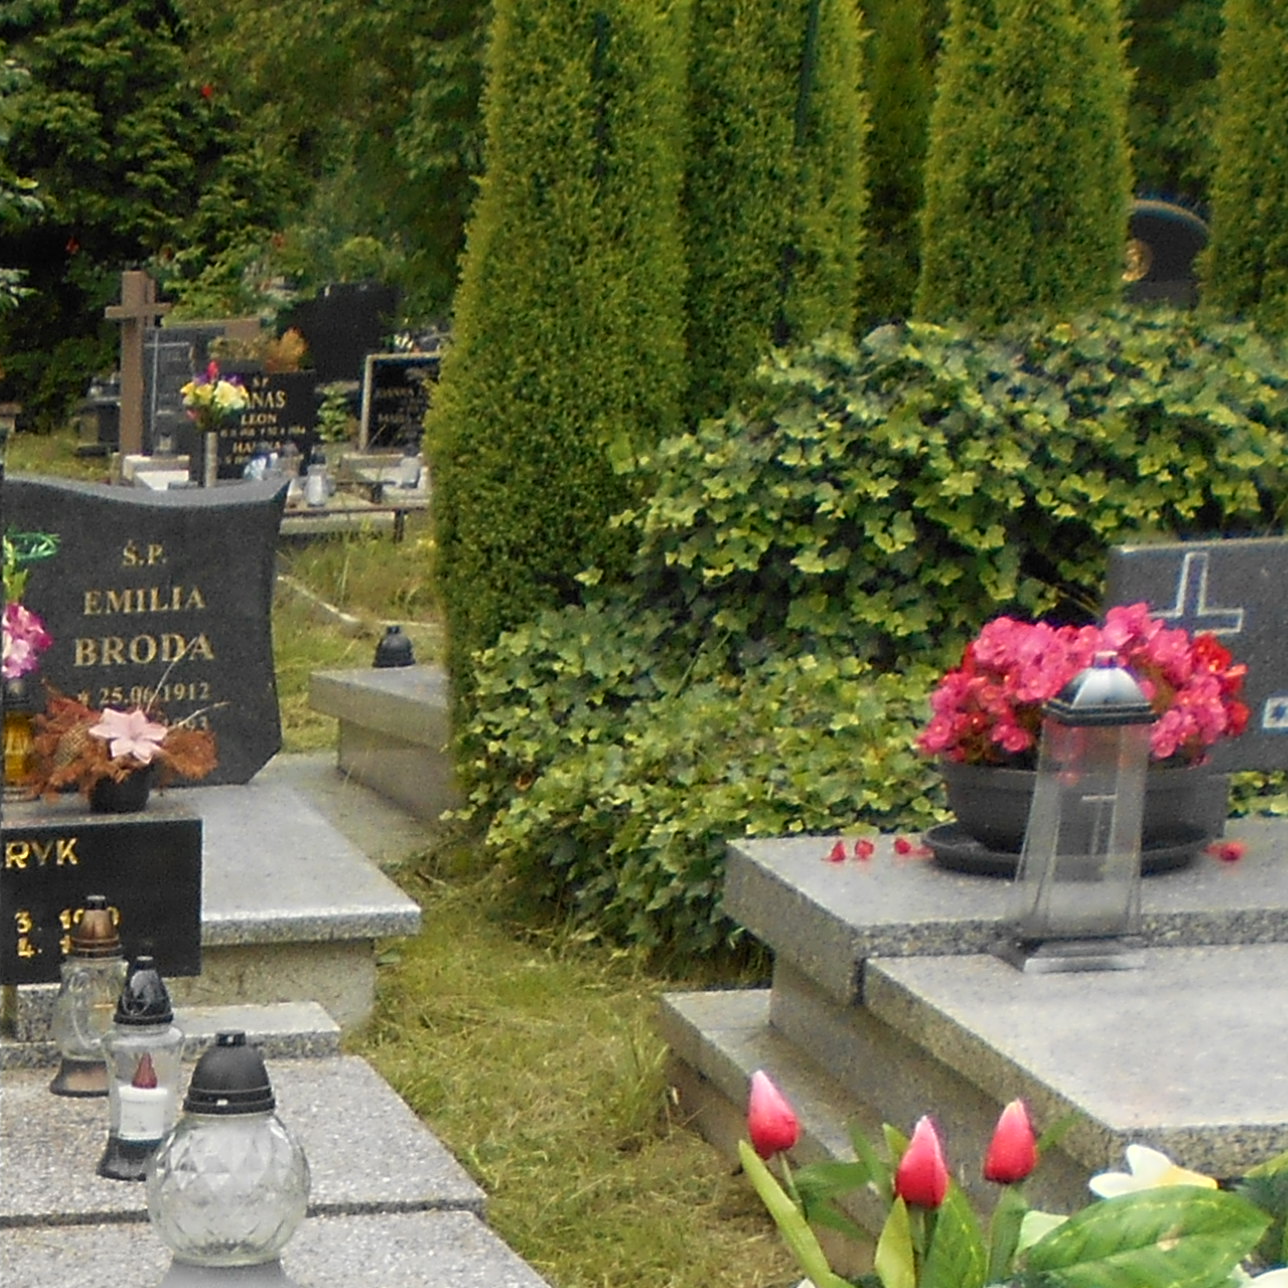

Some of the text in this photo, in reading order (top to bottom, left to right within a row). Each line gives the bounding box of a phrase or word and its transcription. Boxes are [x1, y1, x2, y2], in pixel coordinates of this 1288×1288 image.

[241, 412, 277, 425] LEON
[122, 540, 168, 567] Ś.P.
[83, 585, 206, 615] EMILIA
[74, 633, 215, 667] BRODA
[99, 682, 211, 705] 25.061912
